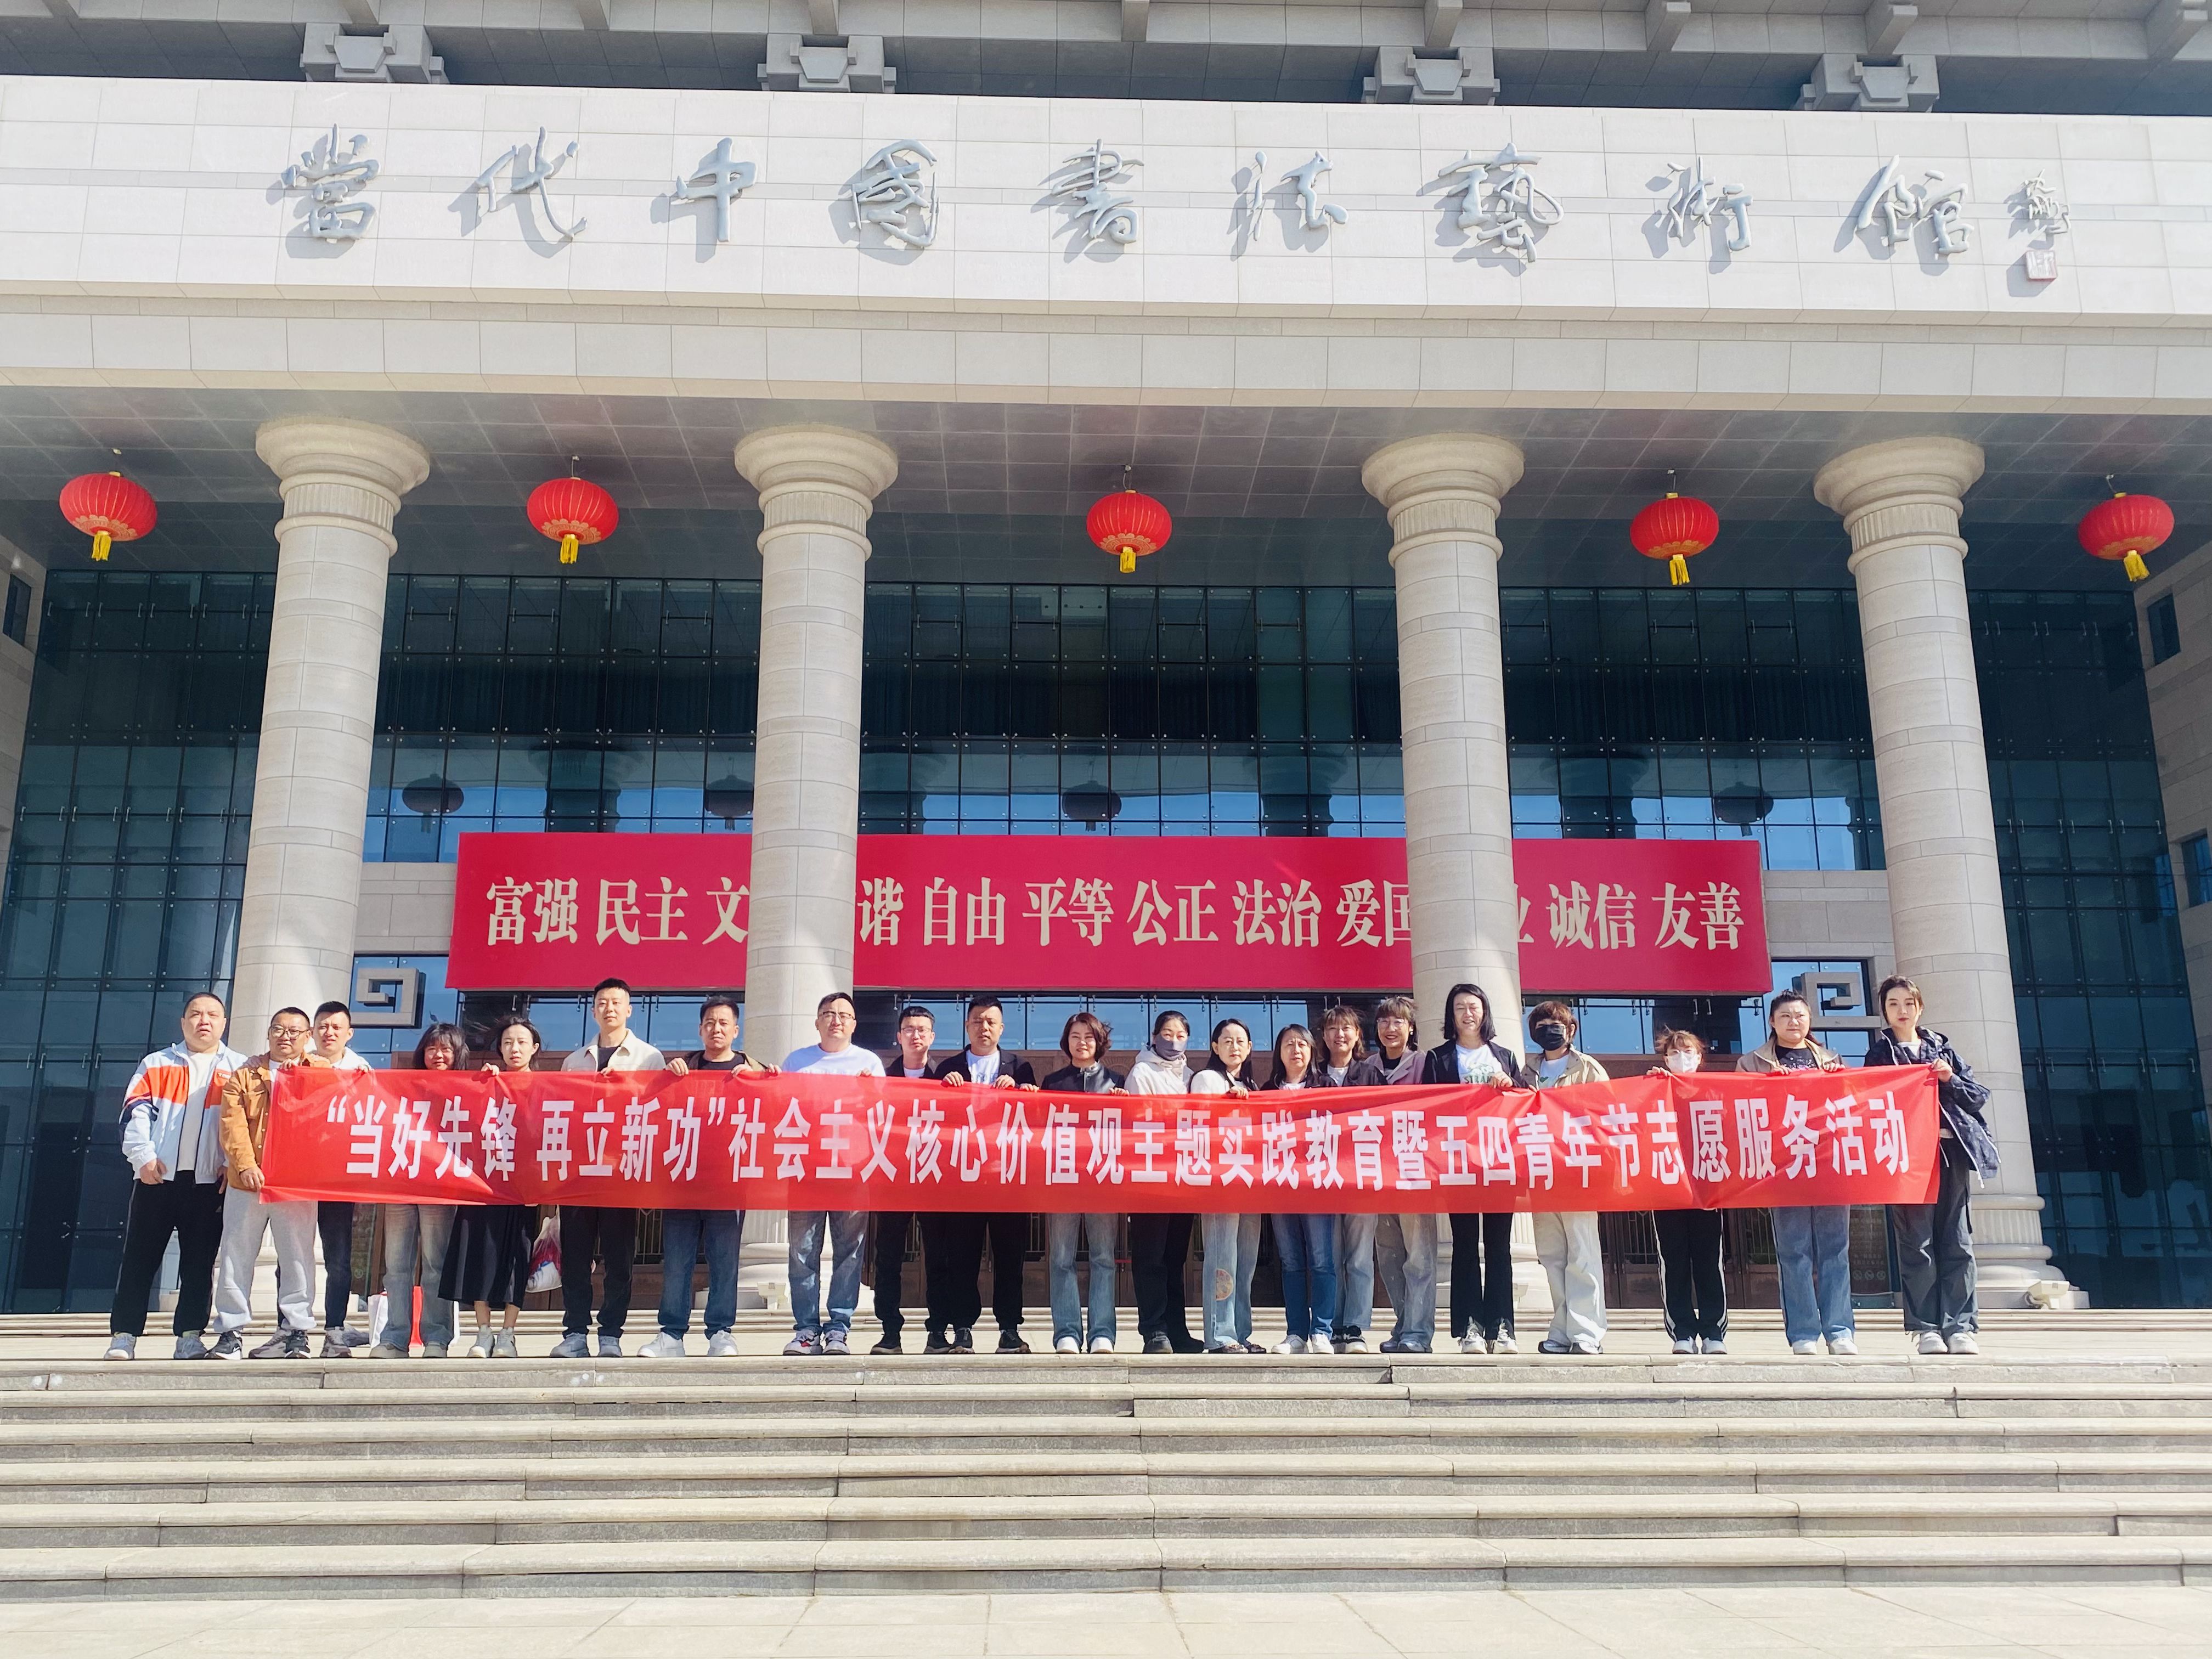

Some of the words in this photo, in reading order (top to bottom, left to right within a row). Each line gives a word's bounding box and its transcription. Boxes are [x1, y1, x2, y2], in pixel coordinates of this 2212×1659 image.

[487, 876, 579, 946] 富强
[596, 876, 688, 946] 民主
[923, 876, 1006, 946] 自由
[1022, 877, 1114, 946] 平等
[1127, 879, 1218, 946] 公正
[1232, 878, 1322, 947] 法治
[1545, 881, 1637, 950] 诚信
[1651, 881, 1744, 950] 友善
